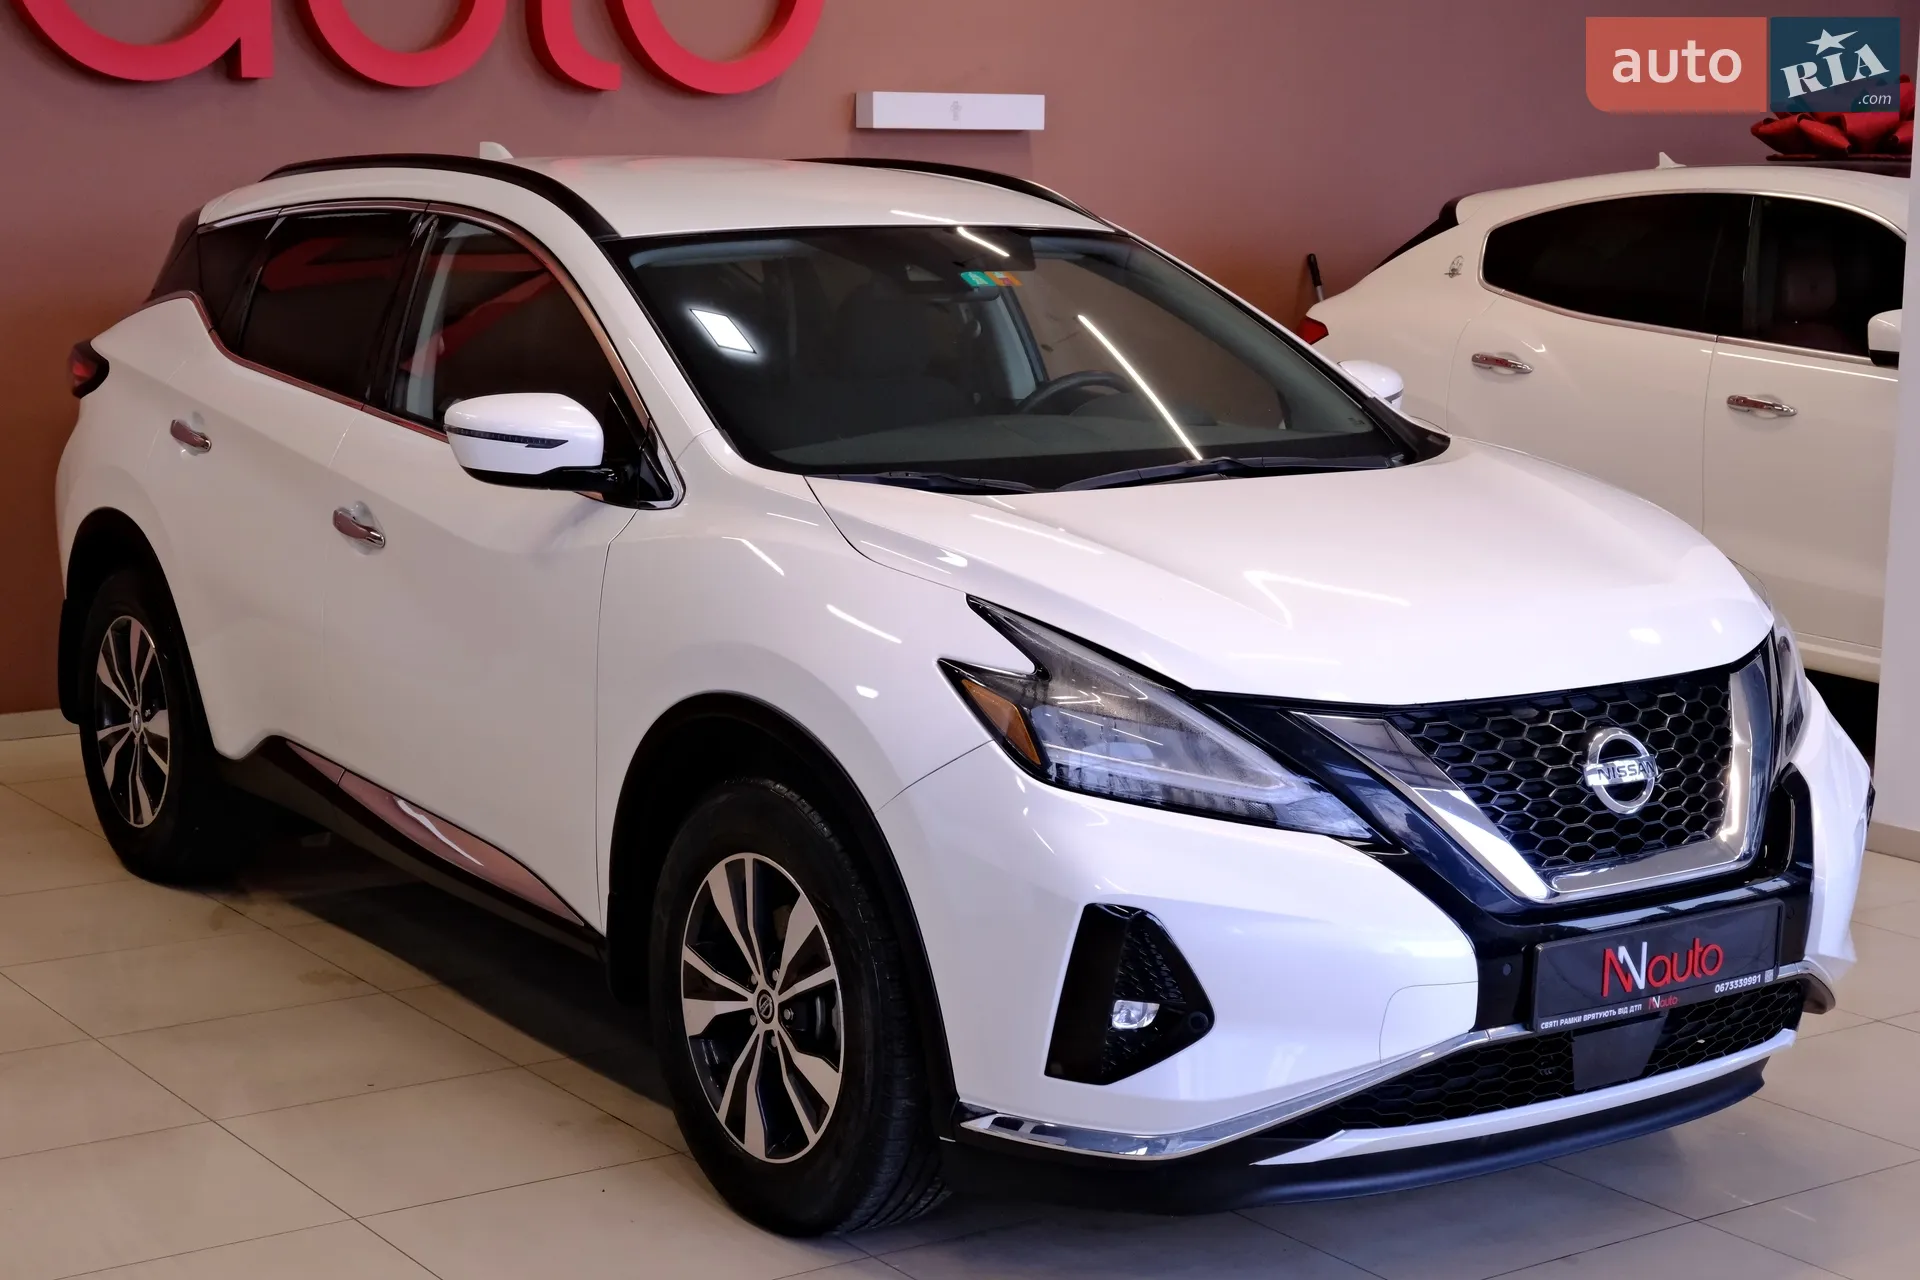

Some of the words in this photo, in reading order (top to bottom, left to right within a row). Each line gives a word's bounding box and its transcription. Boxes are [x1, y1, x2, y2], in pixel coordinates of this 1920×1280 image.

[1597, 761, 1655, 781] NISSAN
[1714, 974, 1761, 993] 0673339991
[1540, 1020, 1559, 1029] СВЯТІ
[1560, 1016, 1582, 1026] РАМКИ
[1629, 1004, 1642, 1013] ДТП
